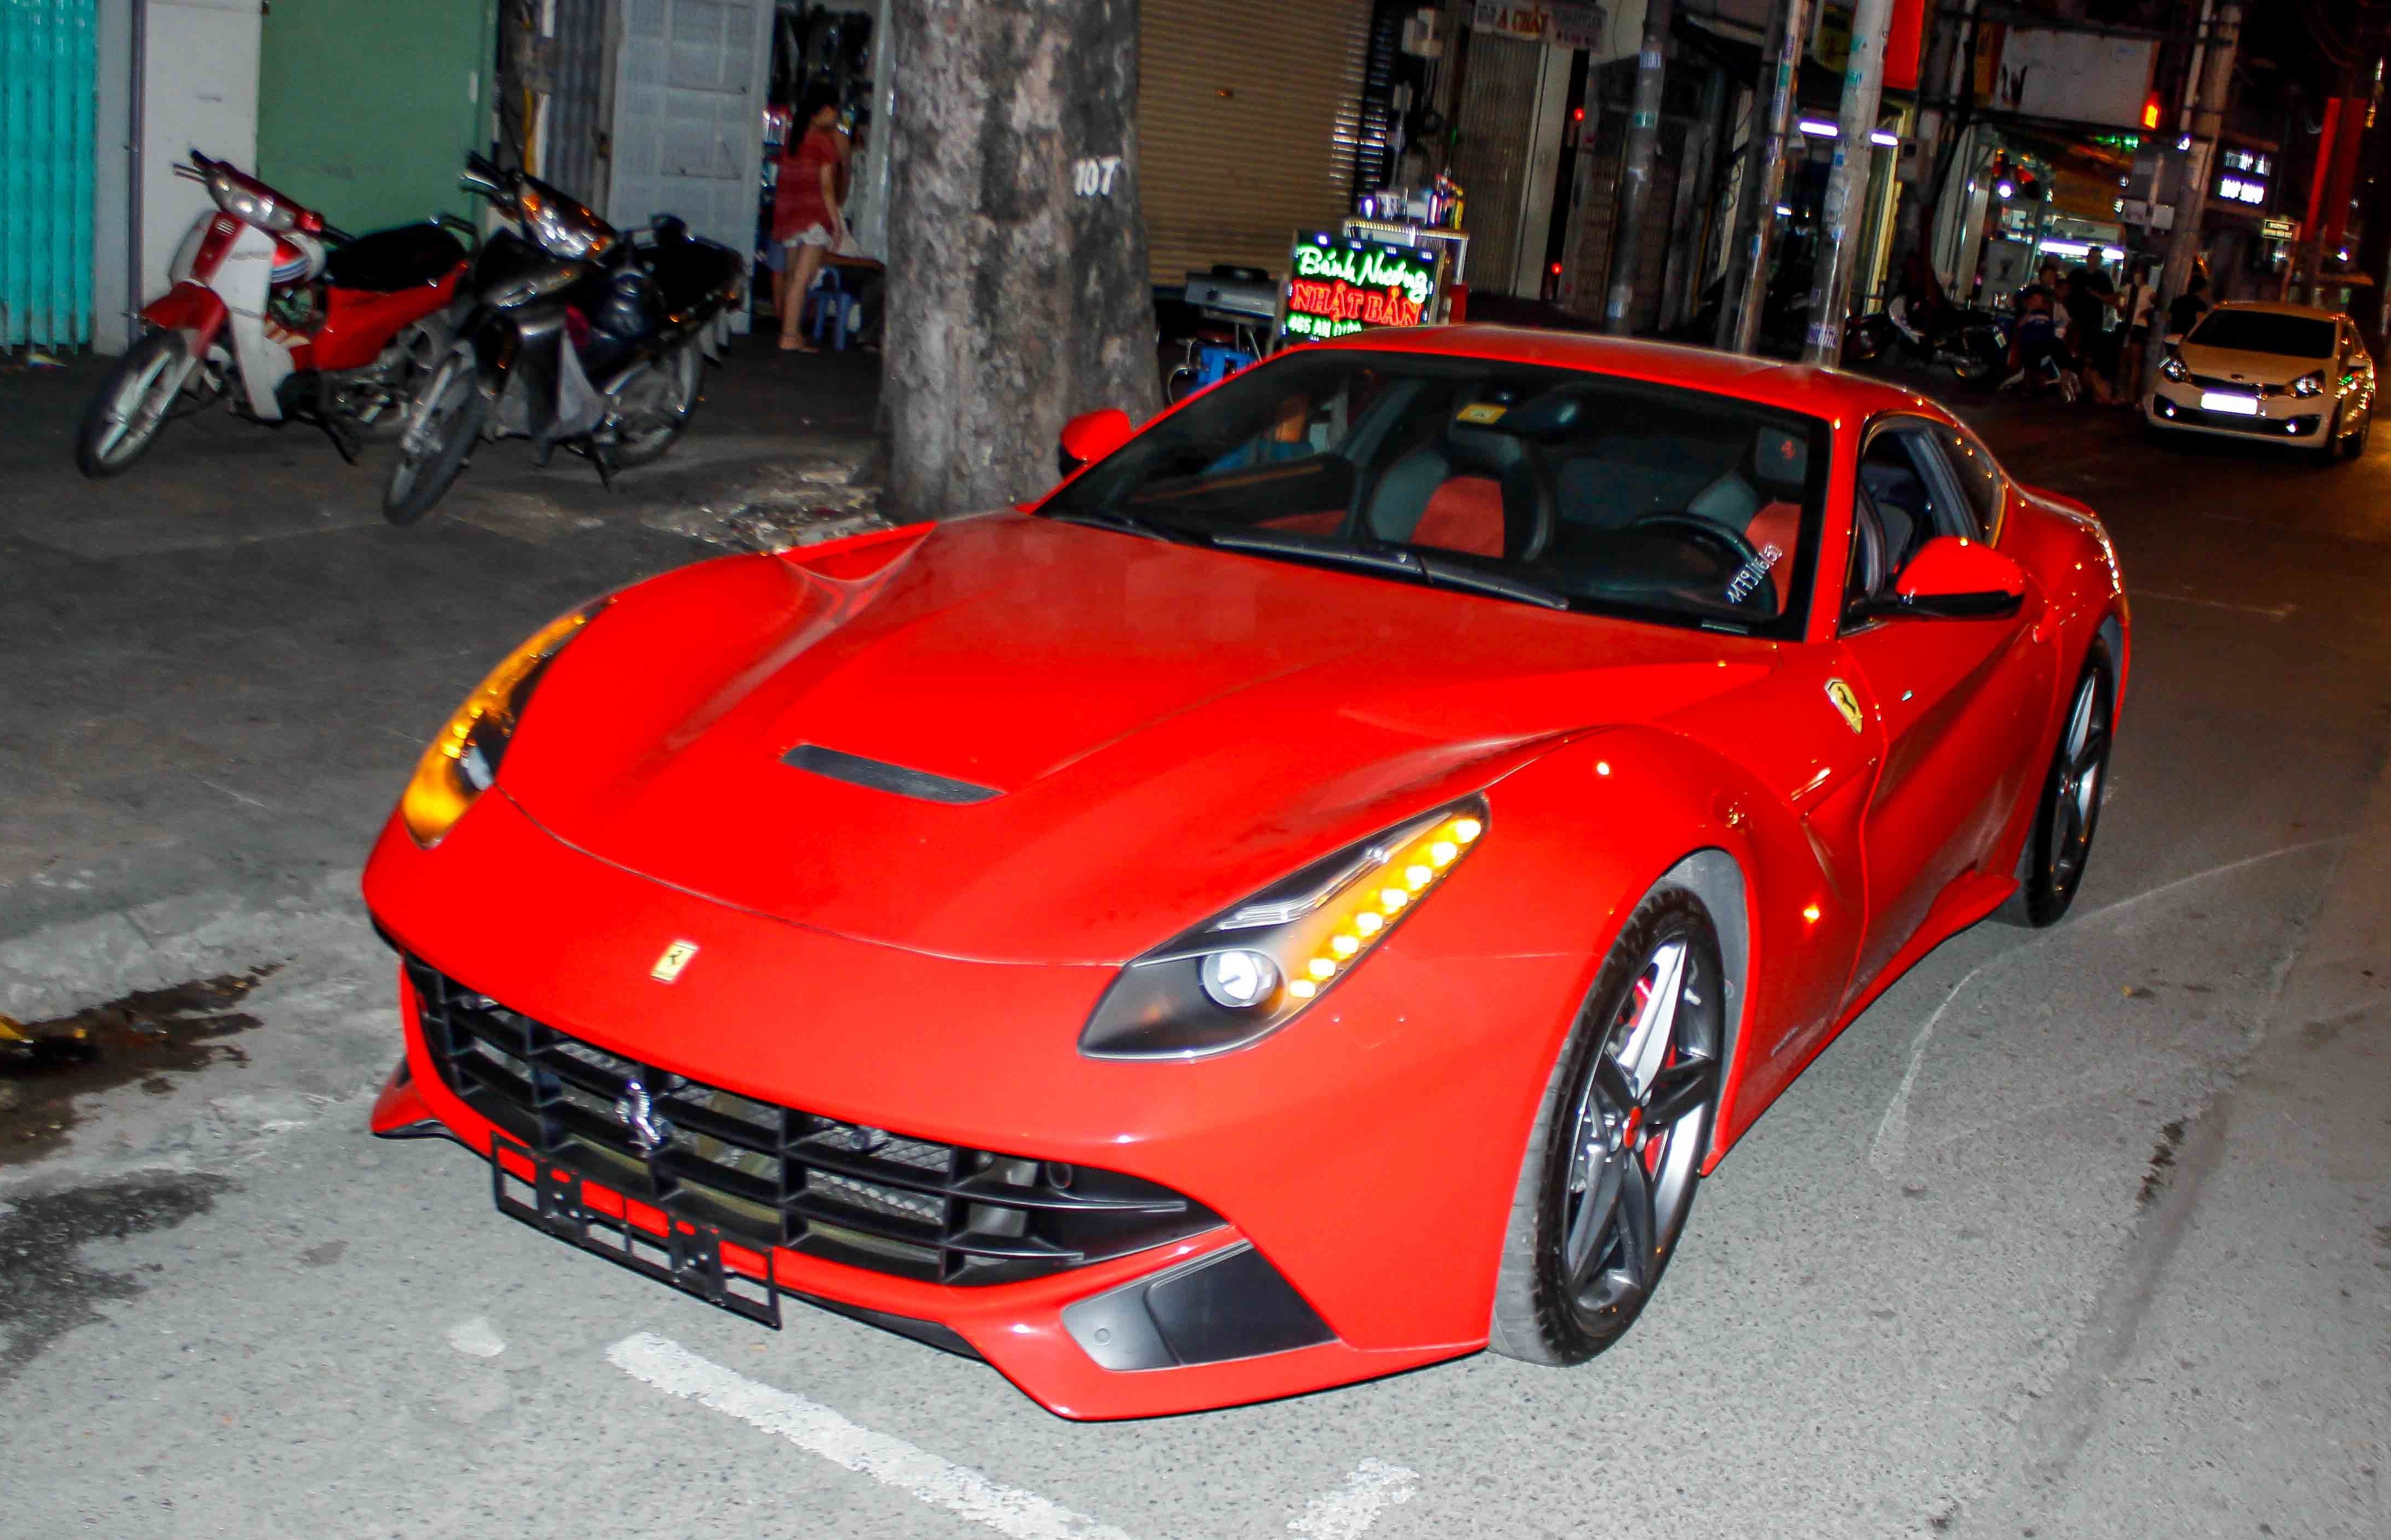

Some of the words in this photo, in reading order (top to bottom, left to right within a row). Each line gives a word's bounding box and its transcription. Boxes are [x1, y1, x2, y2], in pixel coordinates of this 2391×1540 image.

[1298, 246, 1356, 281] Bánh
[1291, 279, 1365, 321] NHẬT
[1363, 286, 1424, 326] BẢN
